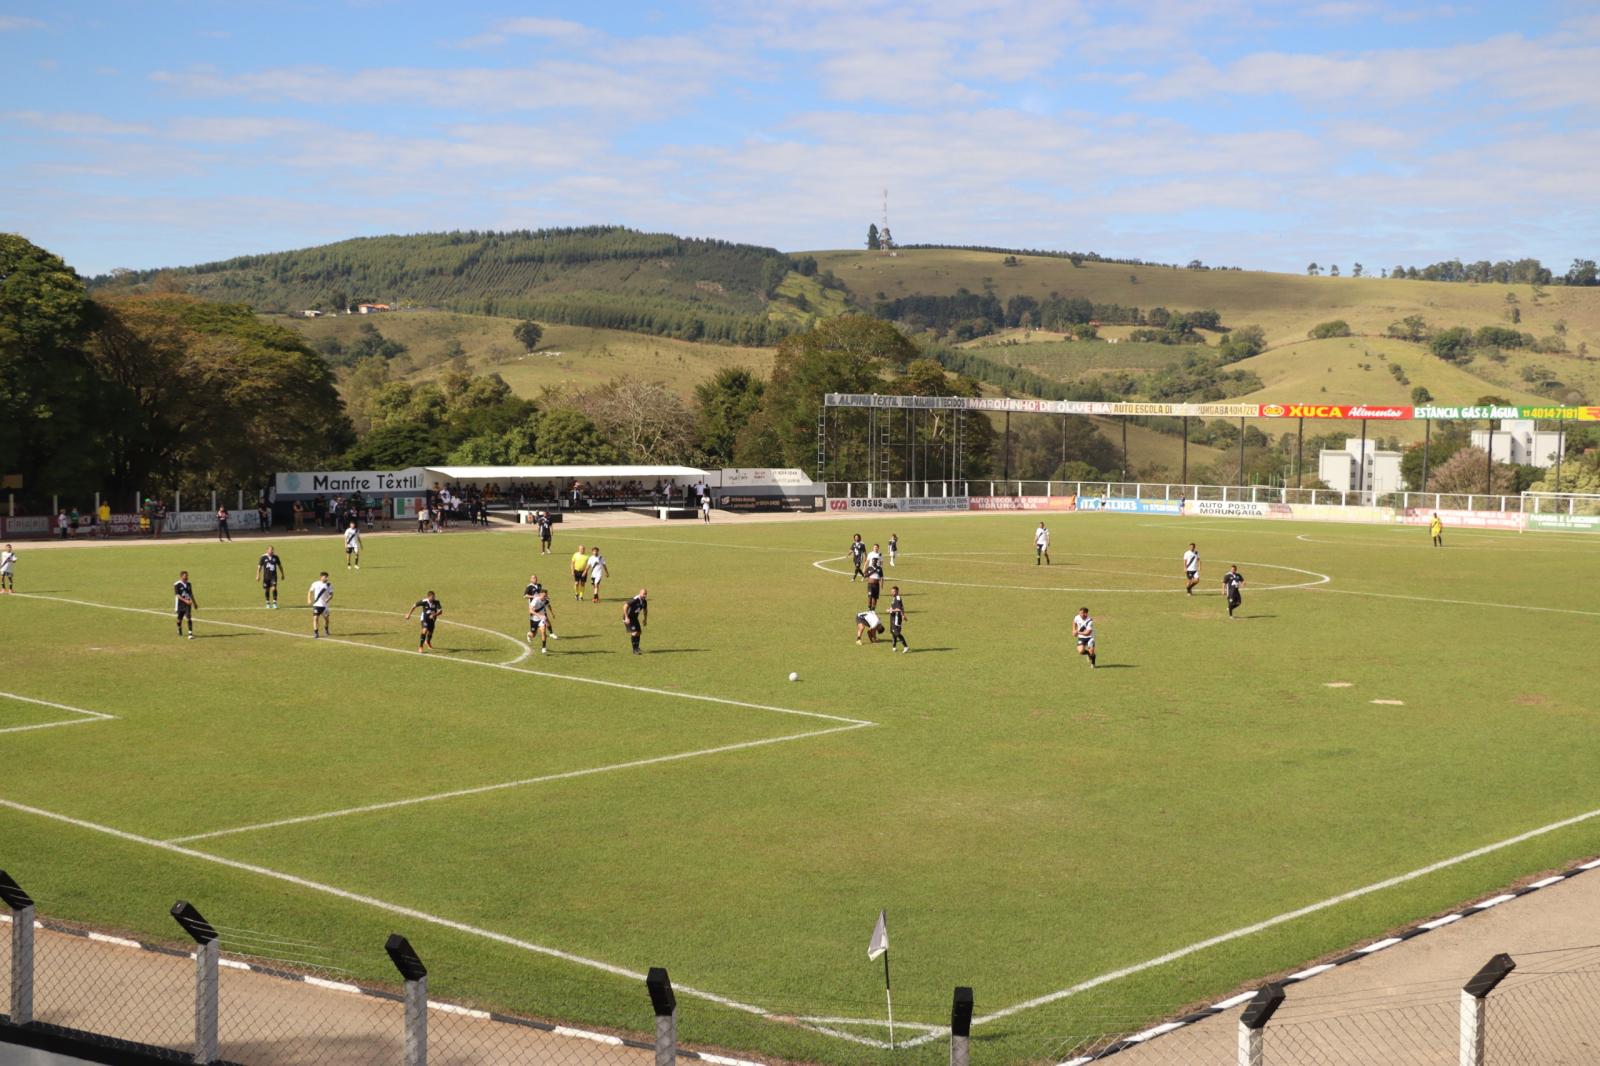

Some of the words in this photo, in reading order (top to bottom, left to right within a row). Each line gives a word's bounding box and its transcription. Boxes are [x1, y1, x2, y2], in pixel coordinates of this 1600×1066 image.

[1114, 404, 1134, 413] AUTO
[1135, 405, 1163, 414] ESCOLA
[1289, 406, 1342, 417] XUCA
[1348, 406, 1403, 417] Alimentos
[313, 475, 371, 491] Manfre
[376, 473, 417, 489] Têxtil
[850, 499, 883, 507] sensus
